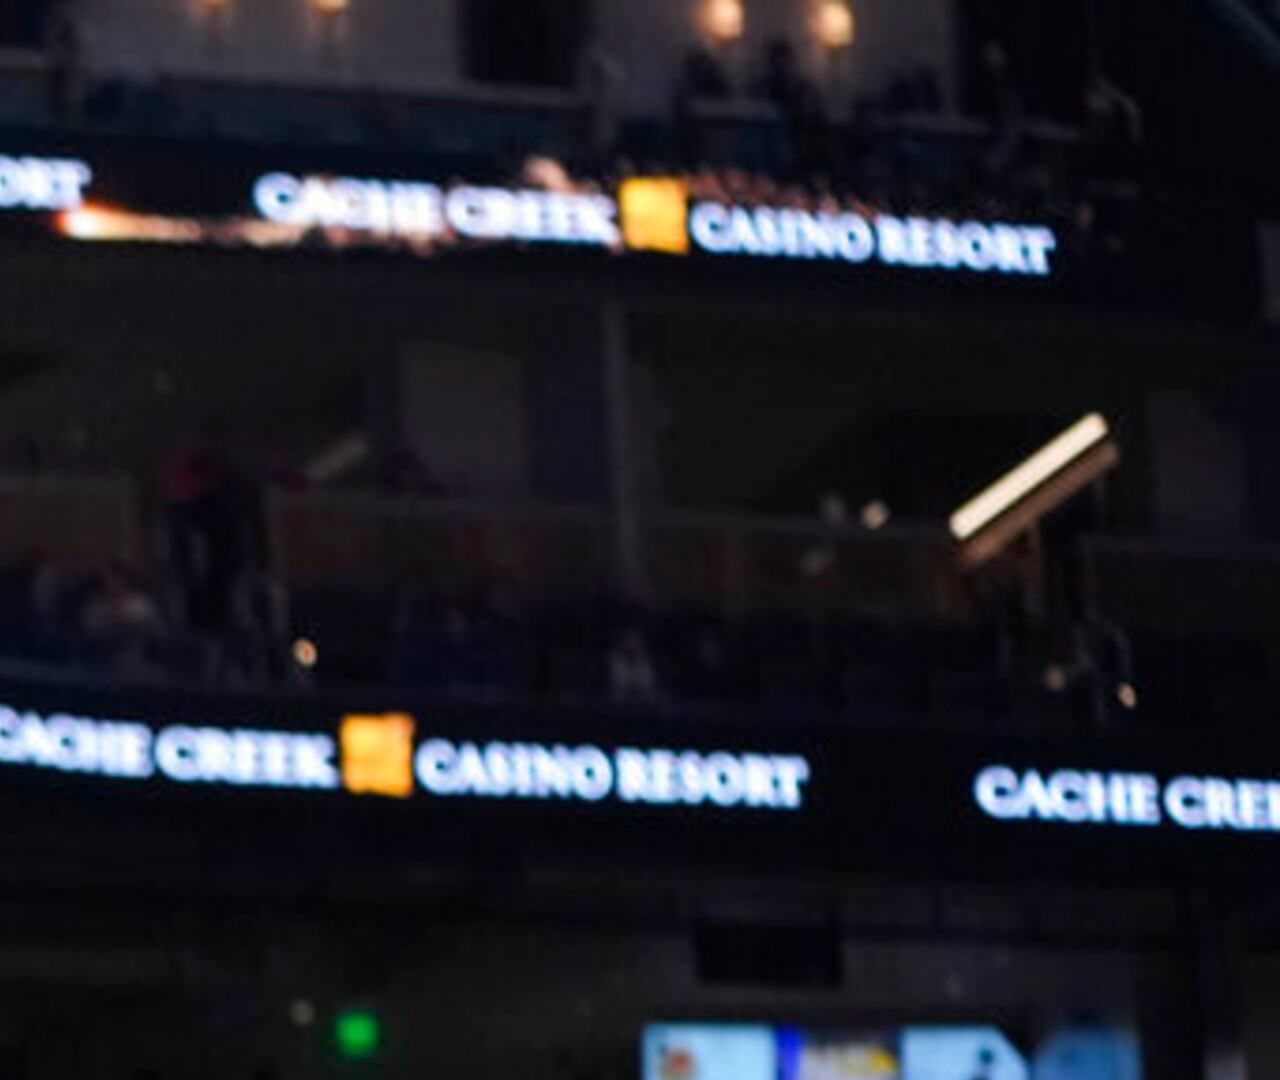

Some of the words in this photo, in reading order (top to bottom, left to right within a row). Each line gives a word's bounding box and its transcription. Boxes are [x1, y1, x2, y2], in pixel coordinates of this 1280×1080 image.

[253, 173, 442, 234] CACHE
[444, 184, 618, 246] CREEK
[689, 202, 875, 262] CASINO
[875, 213, 1056, 274] RESORT
[154, 725, 338, 788] CREEK
[414, 738, 613, 800] CASINO
[613, 747, 809, 808] RESORT
[974, 765, 1162, 825] CACHE
